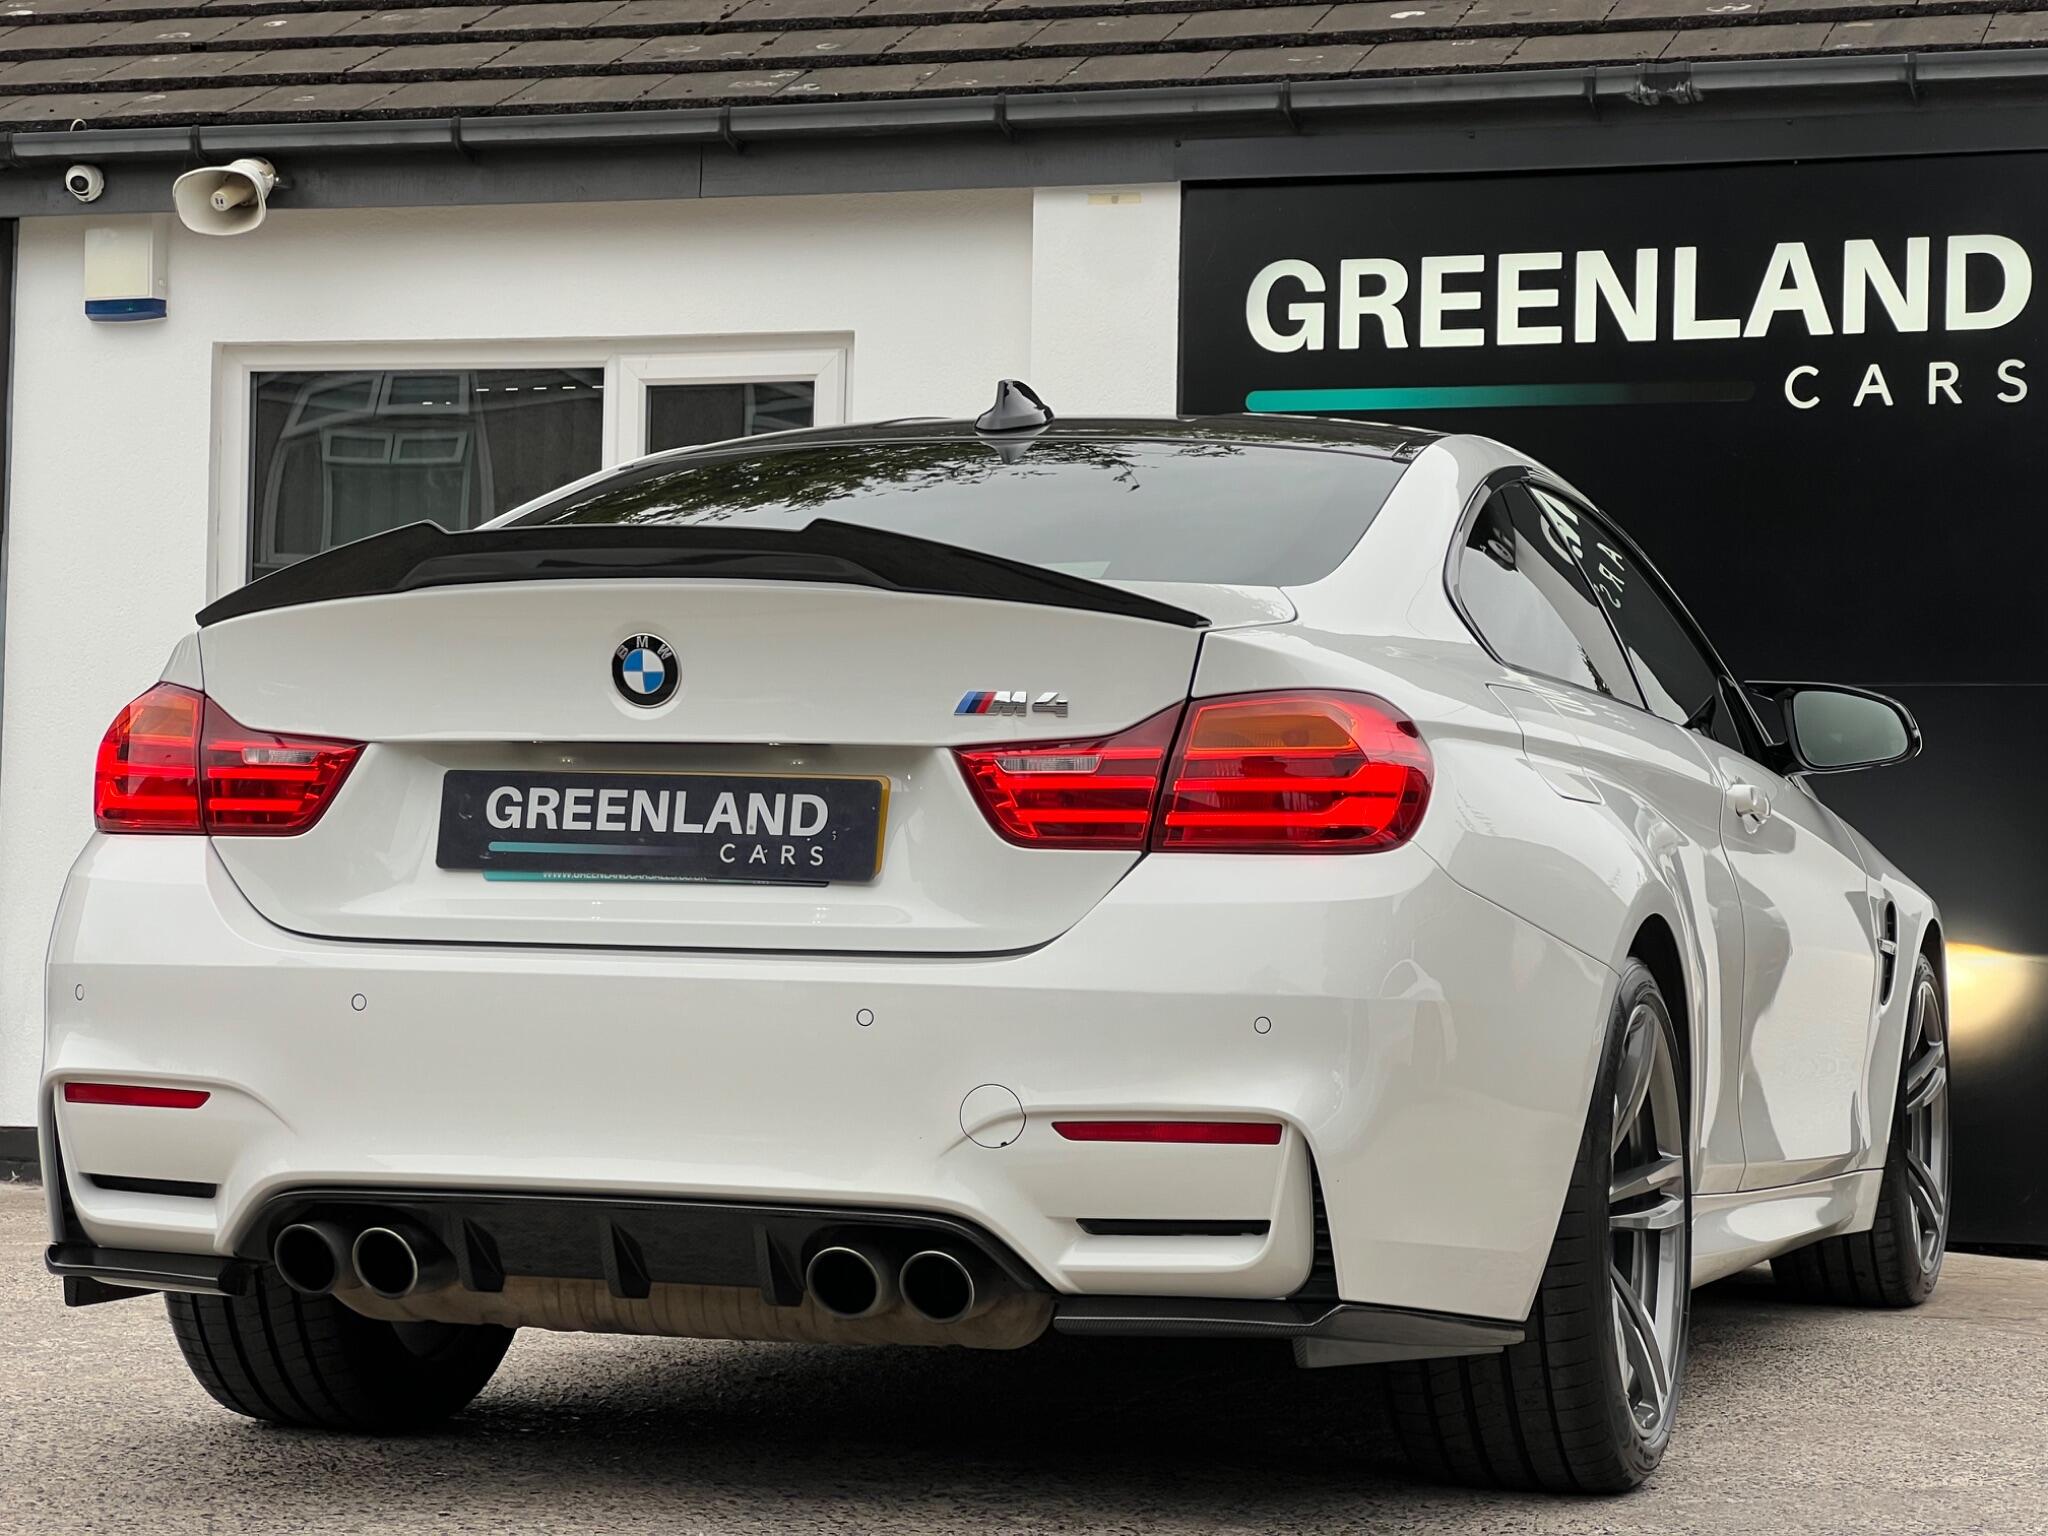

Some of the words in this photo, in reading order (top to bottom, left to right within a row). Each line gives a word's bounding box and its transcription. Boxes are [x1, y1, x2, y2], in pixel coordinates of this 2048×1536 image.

[1245, 234, 2033, 353] GREENLAND
[1784, 358, 2028, 409] CARS
[616, 635, 673, 661] BMW
[984, 690, 1069, 717] M4
[486, 786, 829, 837] GREENLAND
[719, 843, 824, 866] CARS
